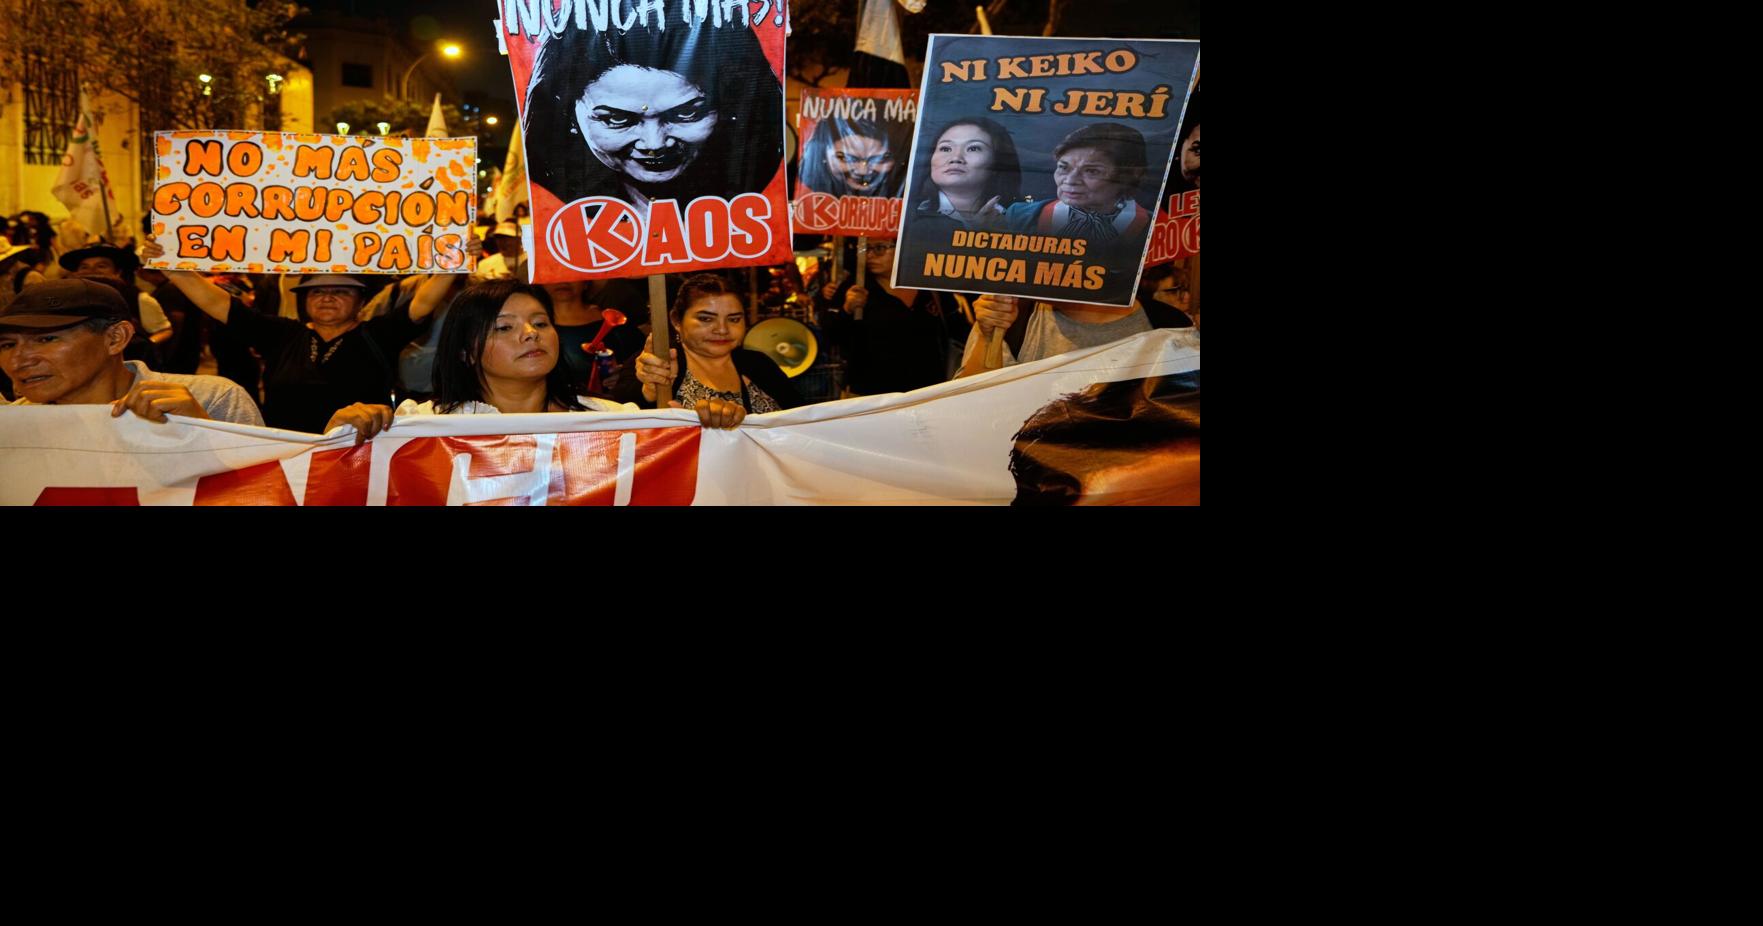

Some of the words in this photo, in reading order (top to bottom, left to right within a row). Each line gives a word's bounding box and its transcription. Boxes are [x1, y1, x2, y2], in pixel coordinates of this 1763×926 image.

[941, 59, 987, 83] NI
[997, 49, 1137, 79] KEIKO
[802, 97, 877, 121] NUNCA
[884, 92, 918, 122] MÁ
[991, 87, 1046, 112] NI
[1054, 86, 1170, 118] JERÍ
[183, 139, 263, 177] NO
[292, 139, 403, 183] MÁS
[153, 176, 470, 228] CORRUPCIÓN
[1168, 188, 1200, 220] LE
[176, 224, 248, 262] EN
[267, 228, 333, 264] MI
[352, 224, 465, 270] PAÍS
[546, 193, 772, 273] KAOS
[951, 230, 1087, 256] DICTADURAS
[923, 253, 1026, 284] NUNCA
[1033, 259, 1106, 290] MÁS
